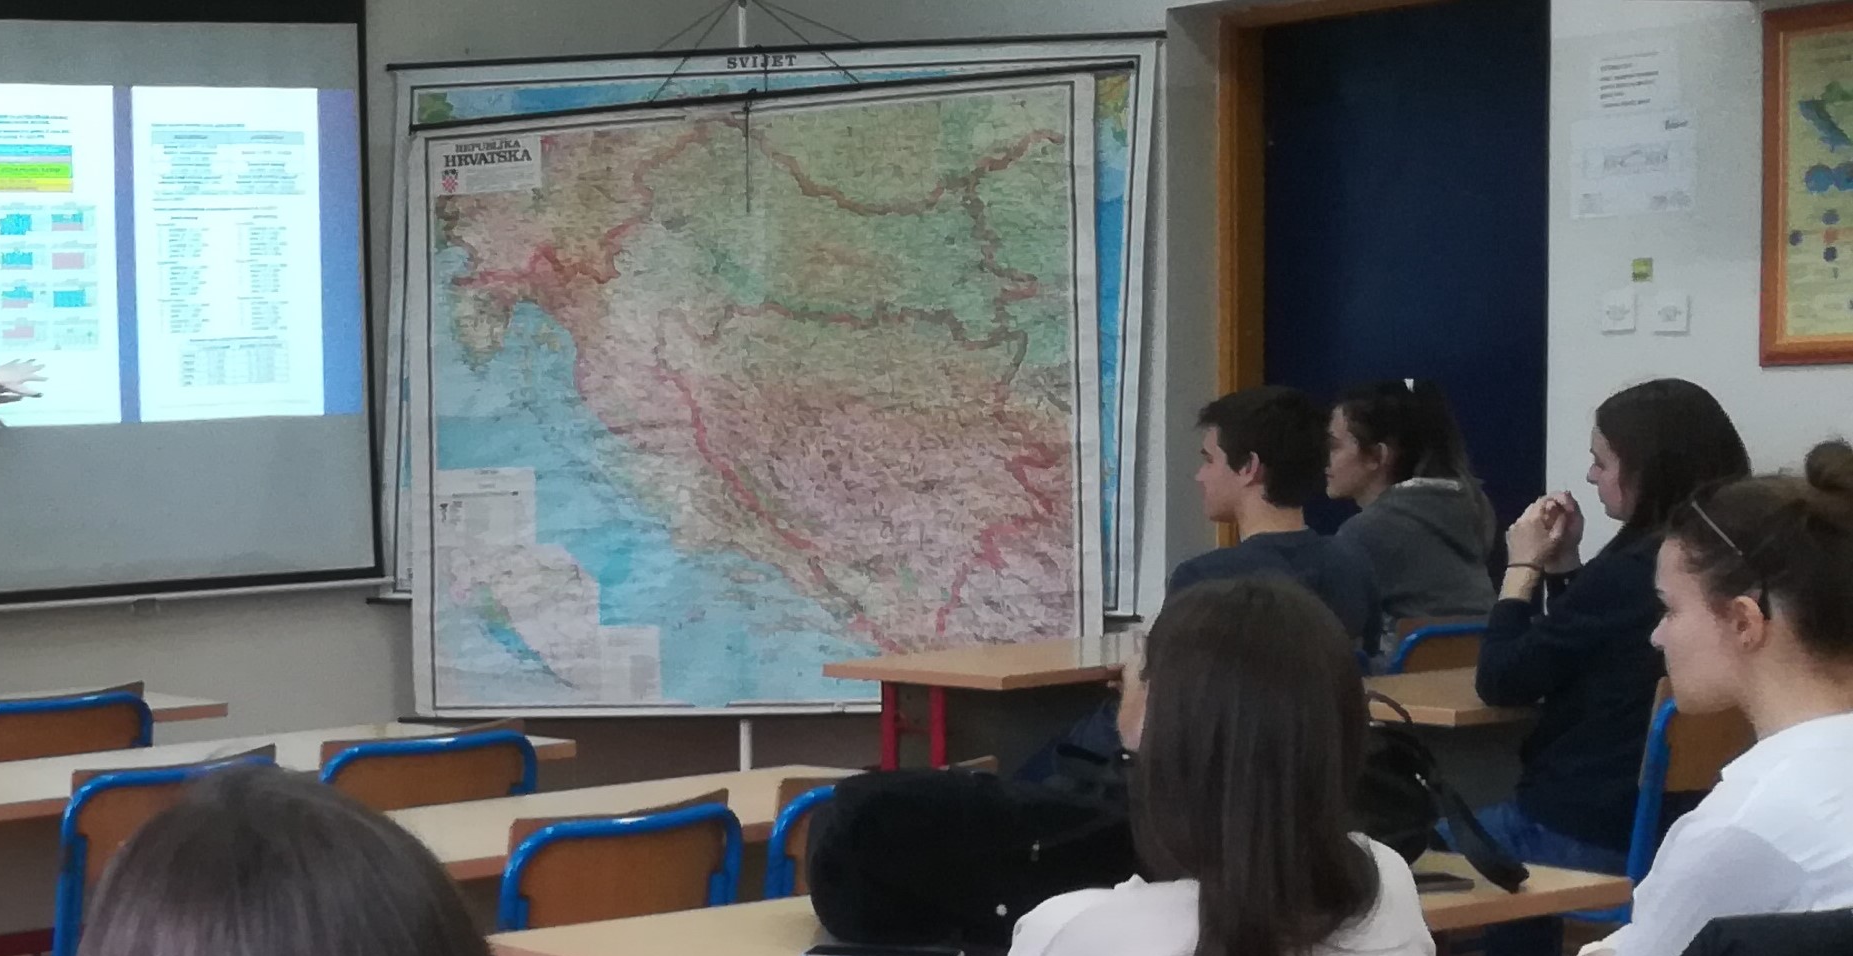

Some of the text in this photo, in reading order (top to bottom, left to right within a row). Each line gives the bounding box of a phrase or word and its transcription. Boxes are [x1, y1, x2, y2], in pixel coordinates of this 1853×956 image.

[726, 54, 797, 69] SVIJET
[455, 140, 521, 153] REPUBLIKA
[443, 149, 533, 167] HRVATSKA
